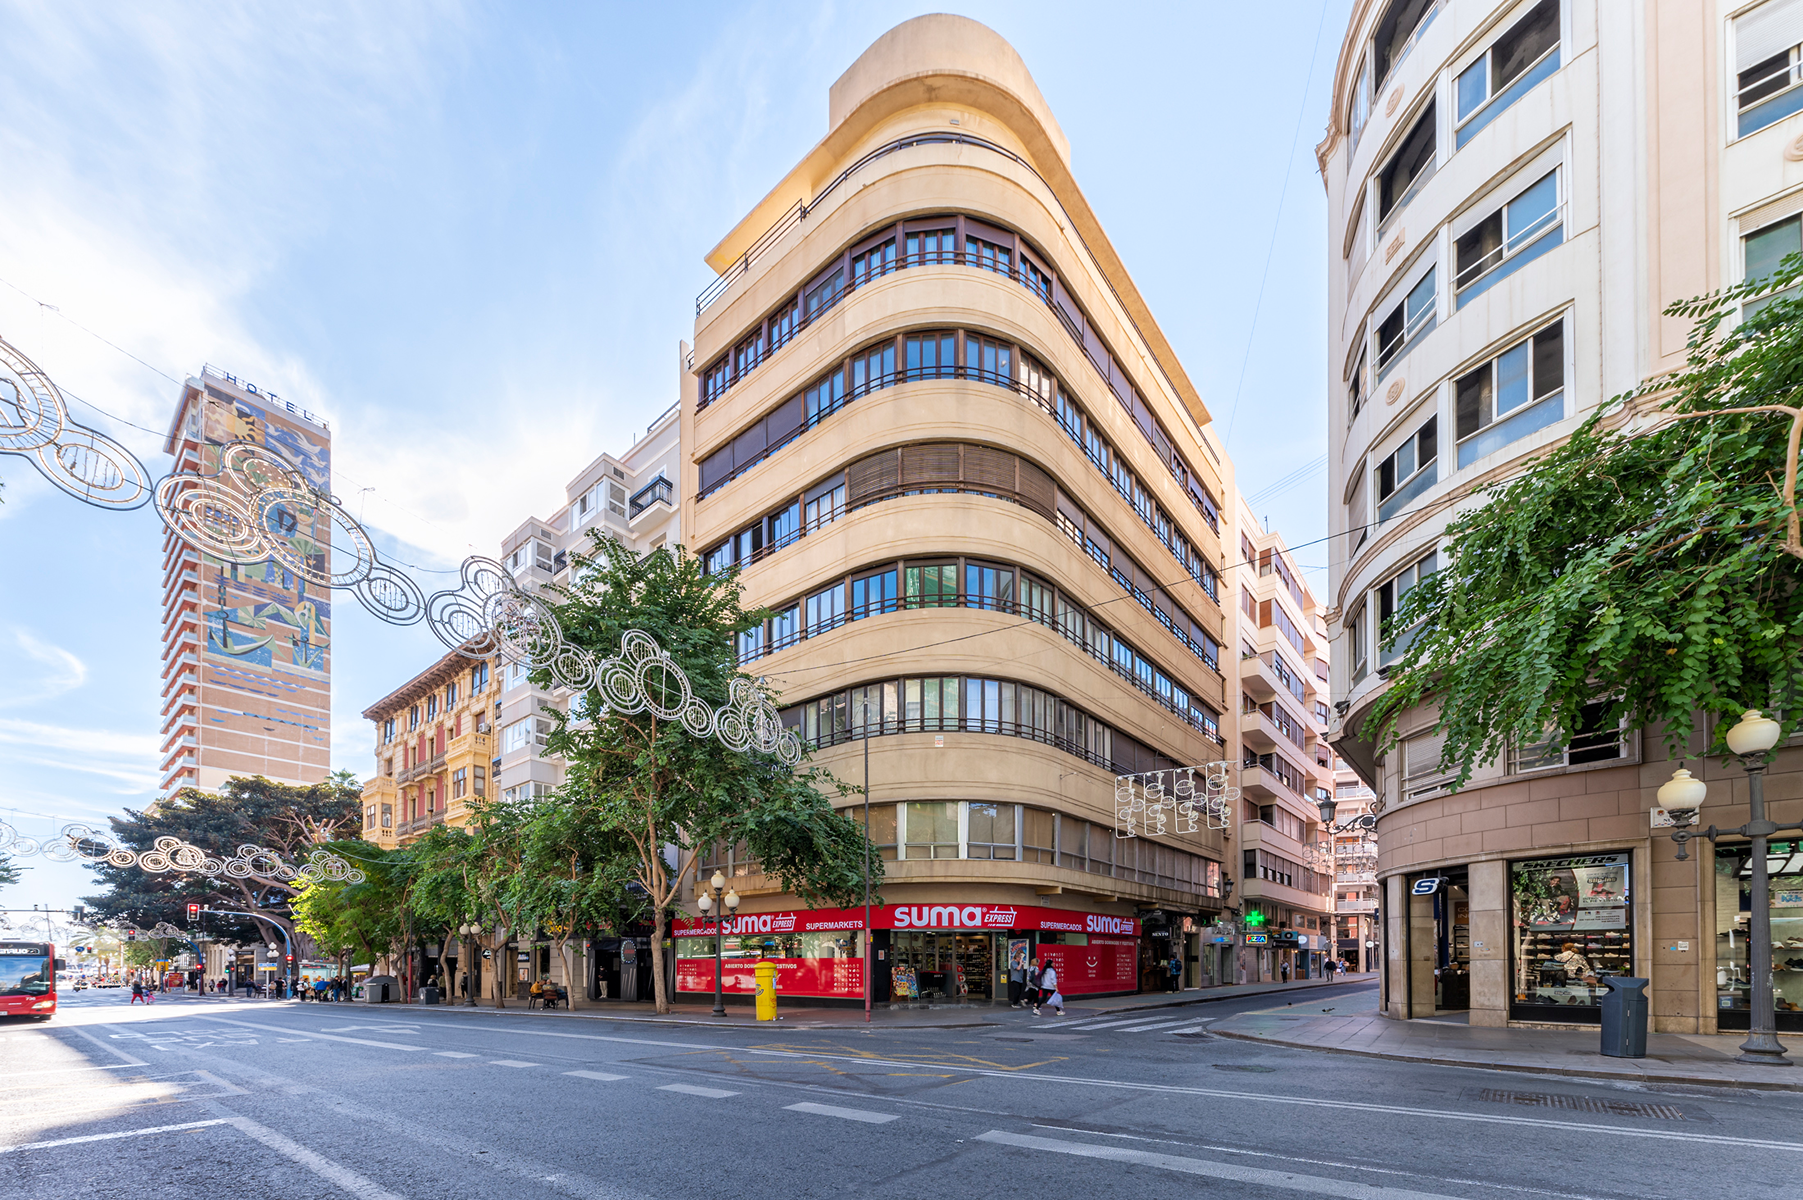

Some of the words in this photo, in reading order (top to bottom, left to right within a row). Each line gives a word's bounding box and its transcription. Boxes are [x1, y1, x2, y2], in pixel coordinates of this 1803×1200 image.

[226, 372, 312, 421] HOTEL
[1521, 855, 1620, 869] SKECHERS
[894, 906, 982, 927] suma
[984, 914, 1012, 923] EXPRESS
[722, 914, 771, 934] suma
[772, 919, 793, 929] EXPRESS
[805, 920, 863, 931] SUPERMARKETS
[1040, 921, 1082, 931] SUPERMERCADOS
[1086, 915, 1120, 934] suma
